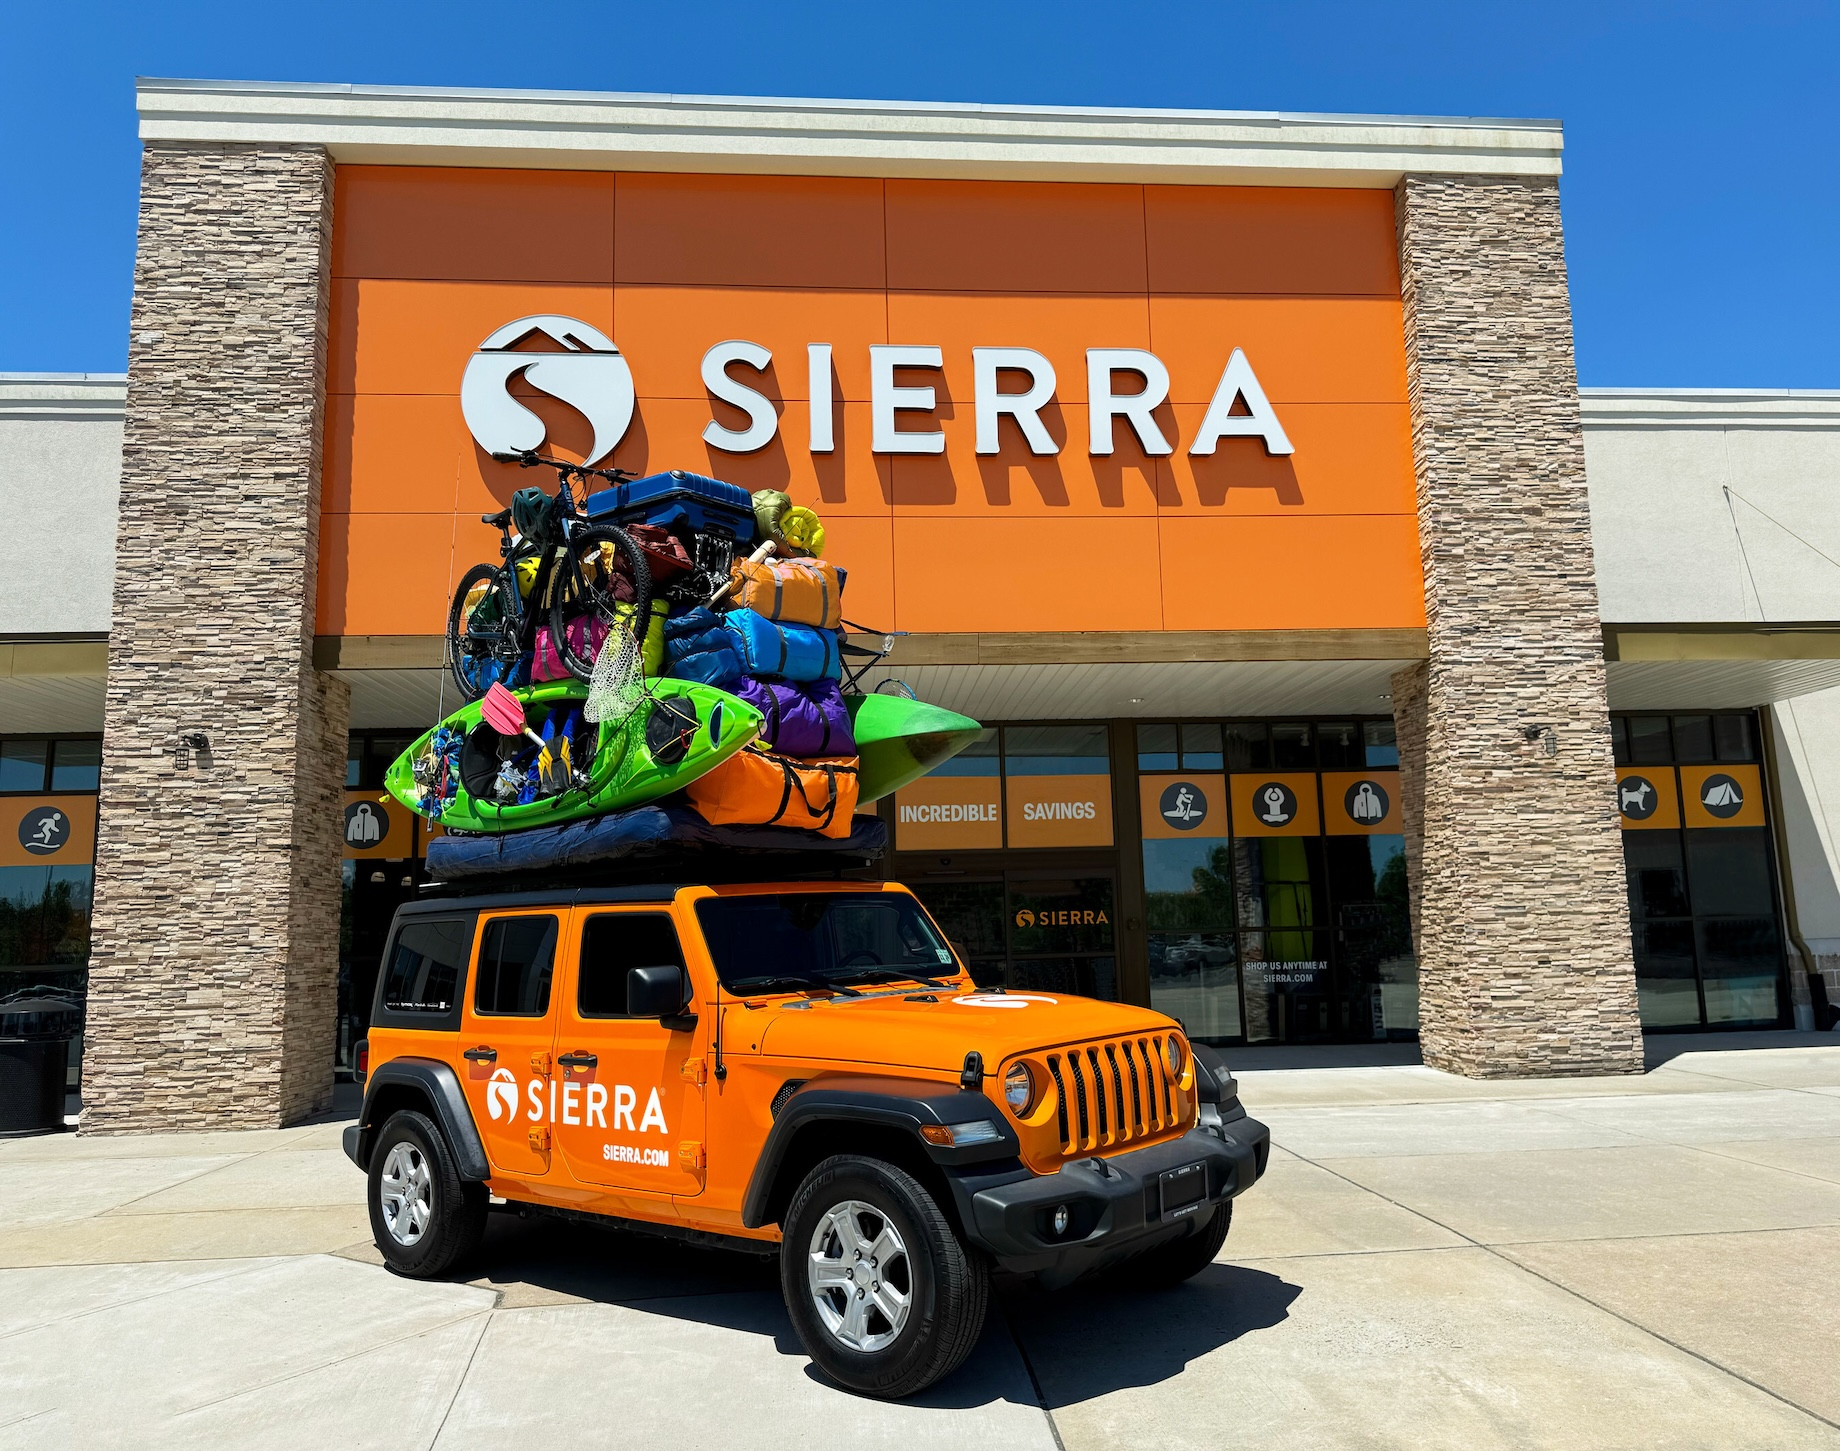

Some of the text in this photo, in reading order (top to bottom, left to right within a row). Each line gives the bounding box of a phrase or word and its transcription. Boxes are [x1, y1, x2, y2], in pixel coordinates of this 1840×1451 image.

[701, 338, 1295, 457] SIERRA
[900, 801, 1096, 823] INCREDIBLE SAVINGS
[1039, 909, 1109, 926] SIERRA
[1246, 961, 1327, 970] SHOP US ANYTIME AT
[1263, 973, 1313, 983] SIERRA.COM
[527, 1079, 669, 1135] SIERRA
[603, 1143, 669, 1167] SIERRA.COM
[793, 1169, 834, 1218] MICHELIN
